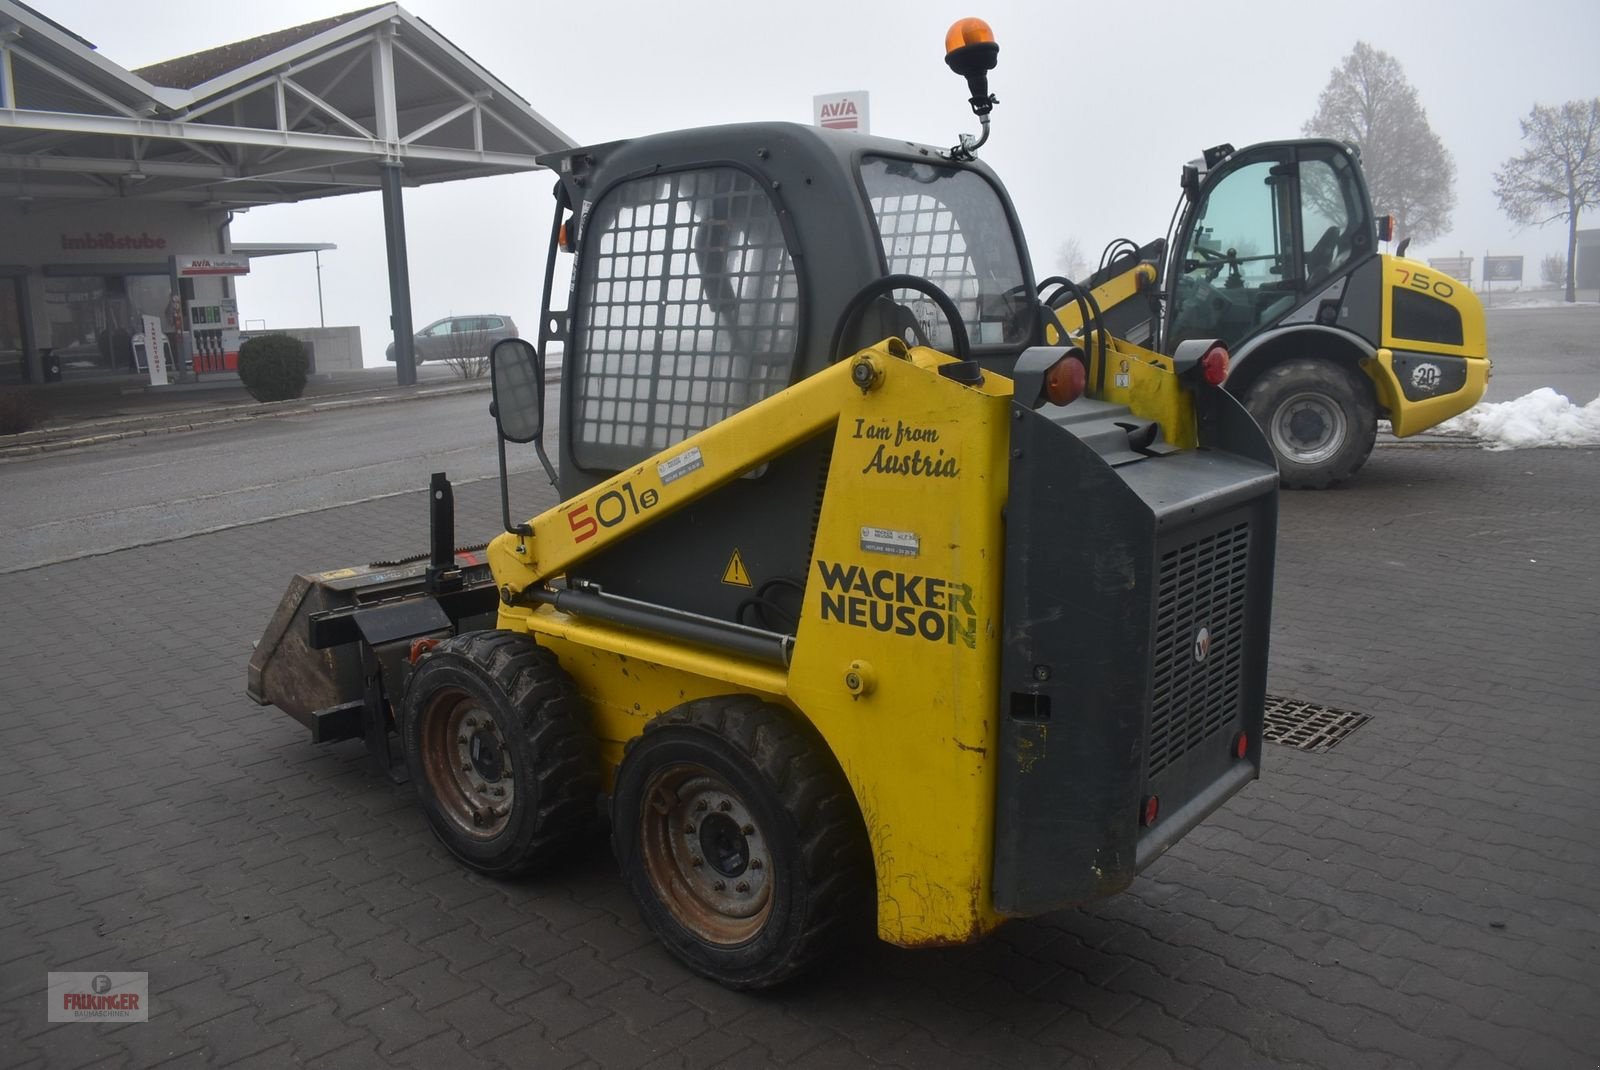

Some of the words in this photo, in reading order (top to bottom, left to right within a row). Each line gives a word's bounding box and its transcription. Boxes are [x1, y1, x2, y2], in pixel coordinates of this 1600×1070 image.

[821, 98, 857, 117] AVIA
[192, 259, 210, 267] AVIA
[1395, 268, 1454, 298] 750
[1417, 367, 1436, 386] 20
[852, 418, 865, 439] I
[866, 424, 892, 441] am
[895, 420, 940, 447] from
[862, 444, 961, 478] Austria
[817, 559, 977, 616] WACKER
[821, 592, 977, 650] NEUSON
